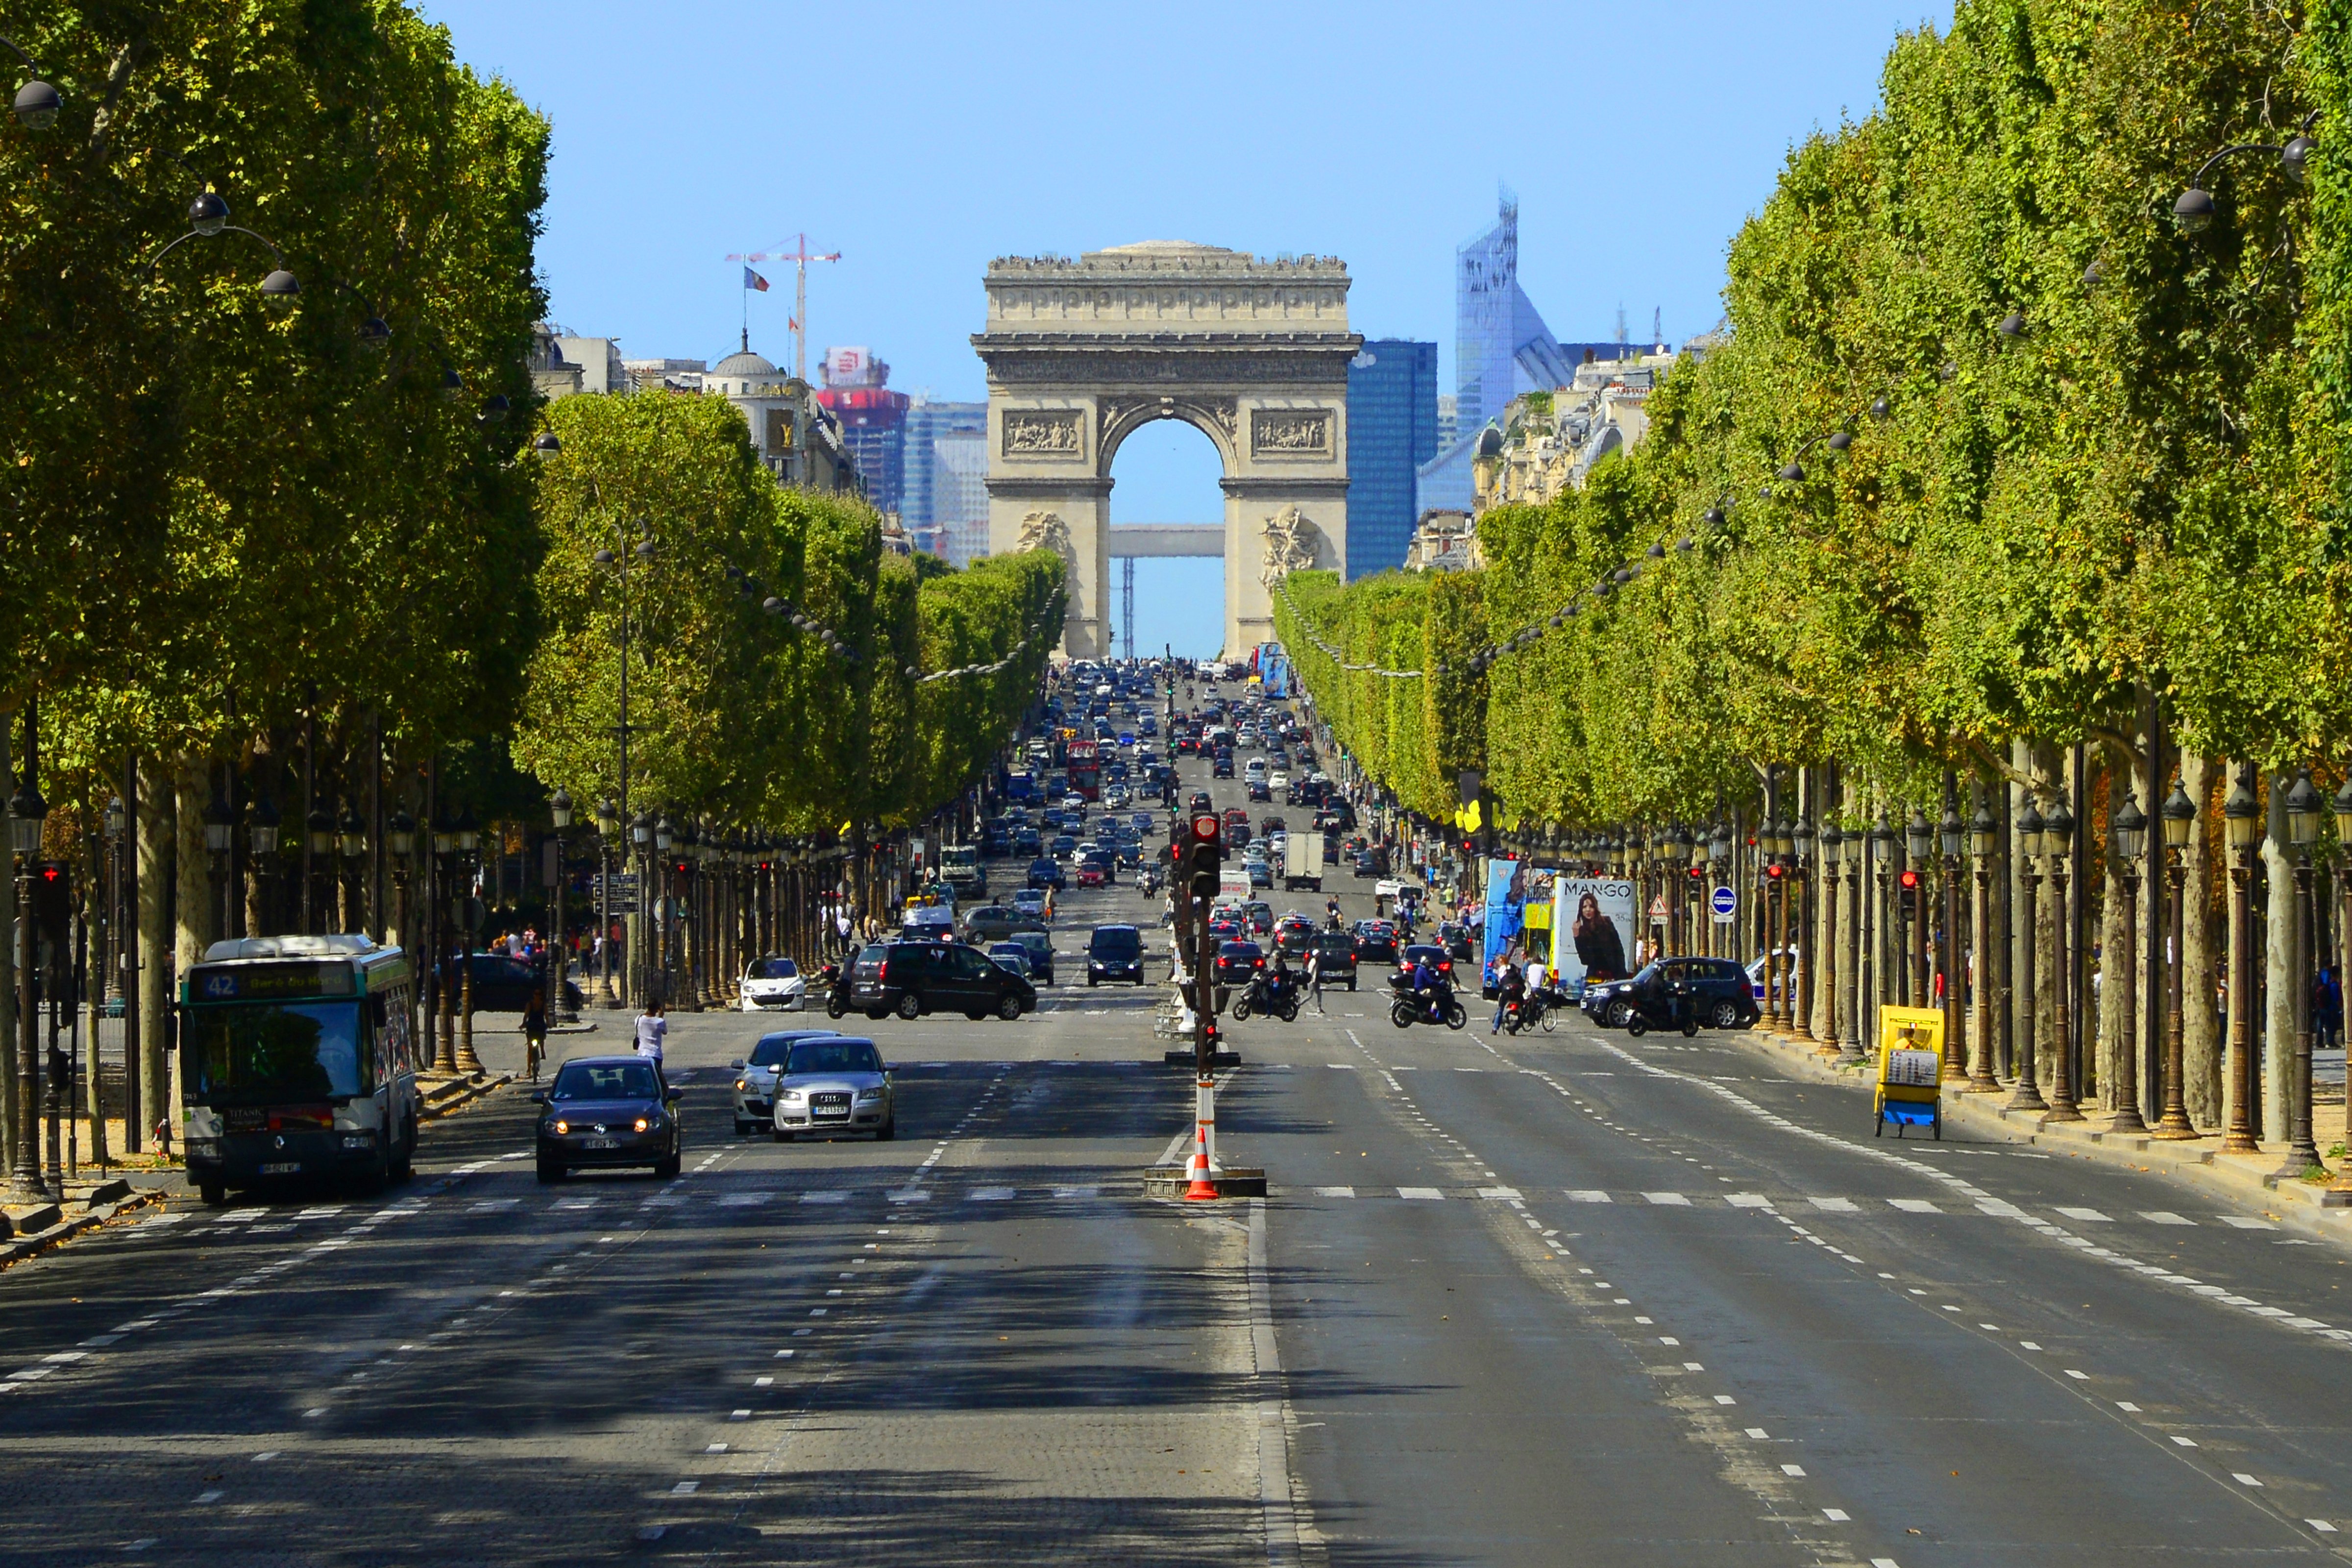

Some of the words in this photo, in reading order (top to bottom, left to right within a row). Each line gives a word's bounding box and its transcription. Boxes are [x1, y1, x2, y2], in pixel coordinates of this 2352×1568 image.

[1565, 882, 1631, 898] MANGO
[208, 976, 234, 994] 42
[230, 1108, 265, 1118] TITANIC
